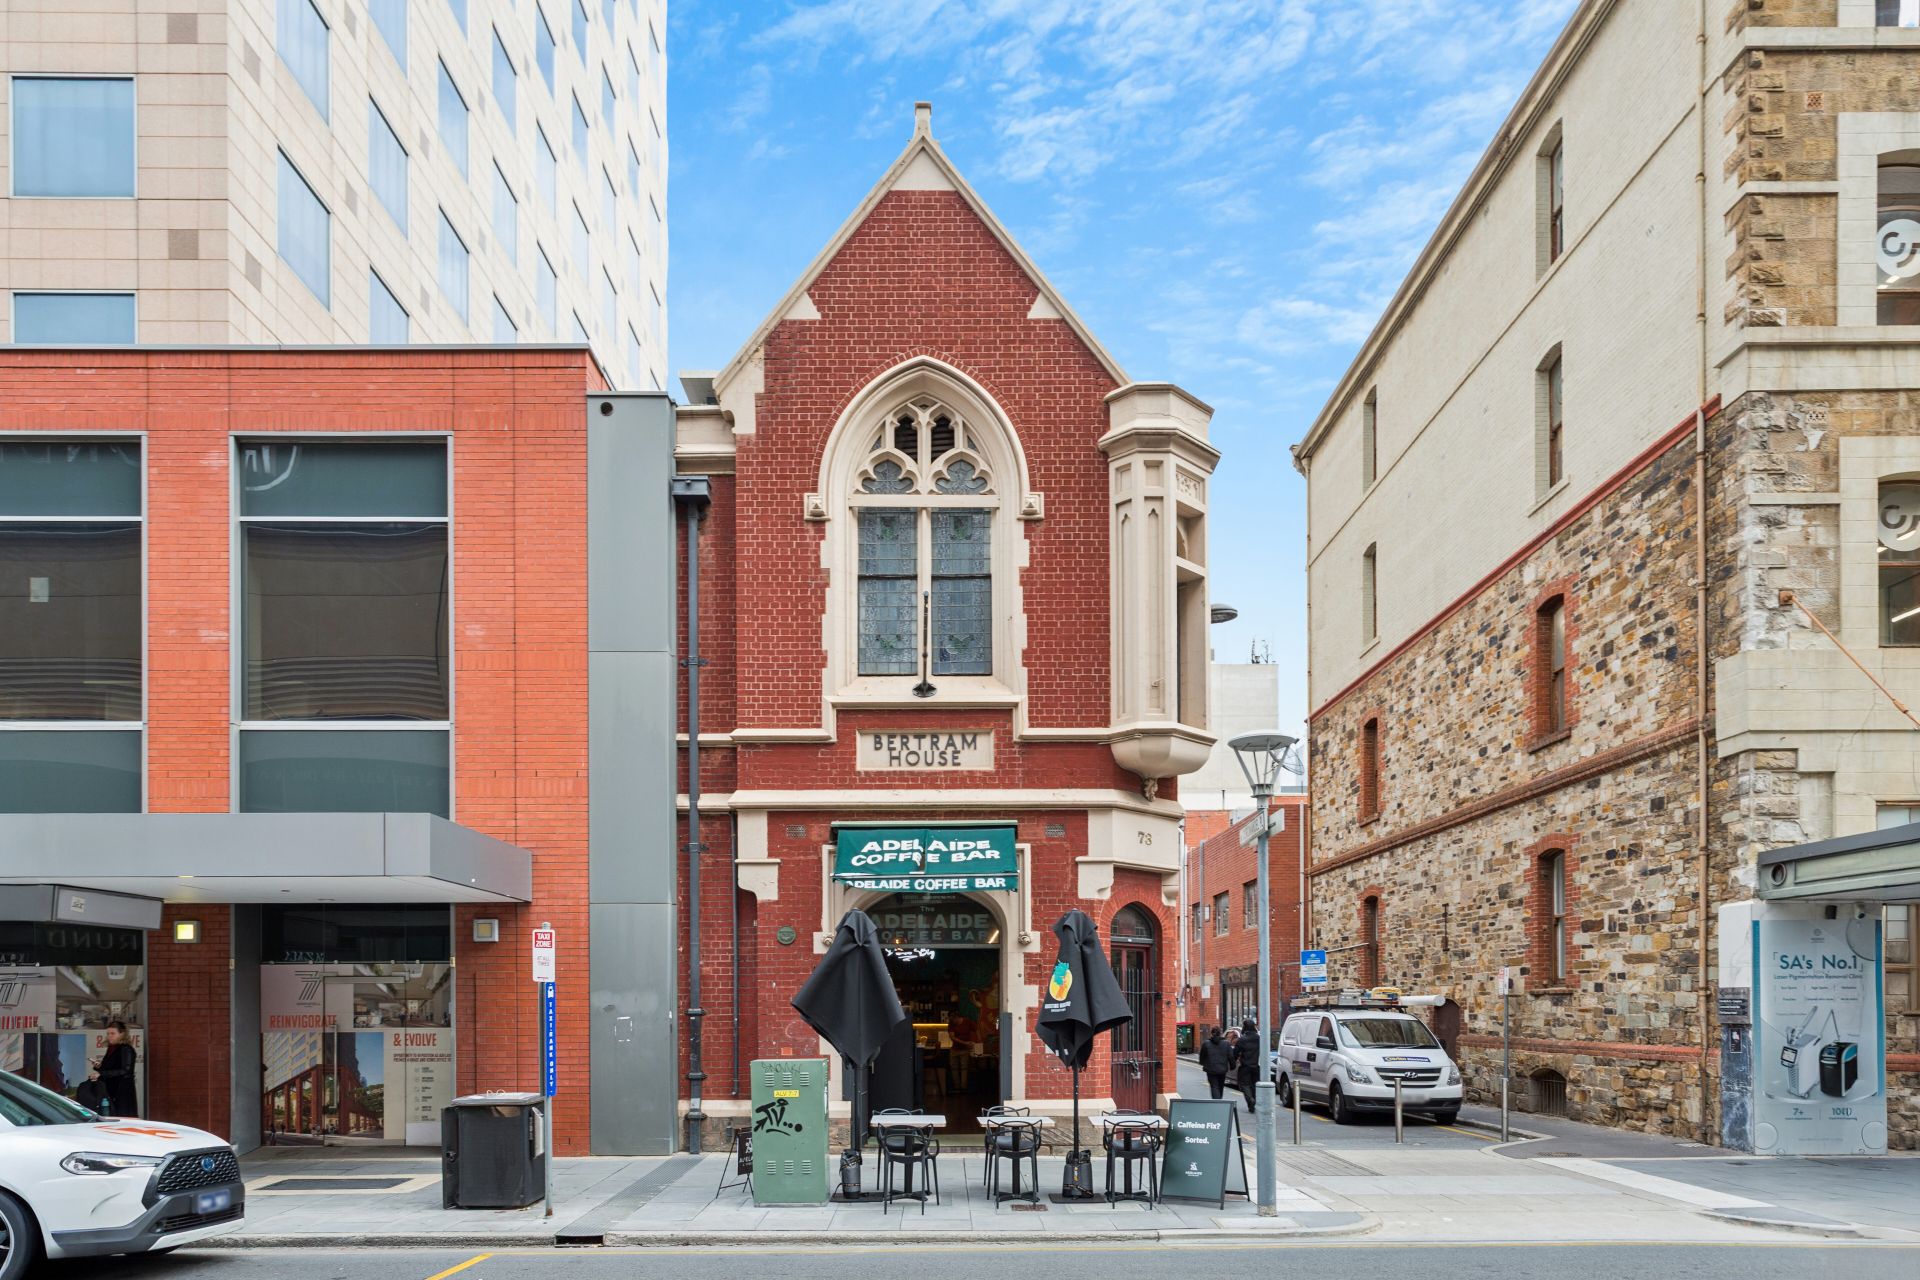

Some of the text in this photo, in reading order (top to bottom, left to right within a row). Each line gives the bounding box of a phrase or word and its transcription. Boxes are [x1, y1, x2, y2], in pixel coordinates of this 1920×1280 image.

[874, 734, 977, 750] BERTRAM
[890, 751, 961, 767] HOUSE
[1137, 831, 1152, 846] 73
[861, 839, 991, 852] ADELAIDE
[951, 850, 1001, 862] BAR
[914, 878, 968, 890] COFFEE
[975, 877, 1006, 888] BAR
[881, 930, 946, 941] OFFEE
[1779, 954, 1858, 970] SA's No.1
[269, 1014, 337, 1029] REINVIGORATE
[393, 1033, 437, 1047] & EVOLVE
[1177, 1121, 1221, 1130] Caffeine Fix?
[1184, 1136, 1210, 1144] Sorted.
